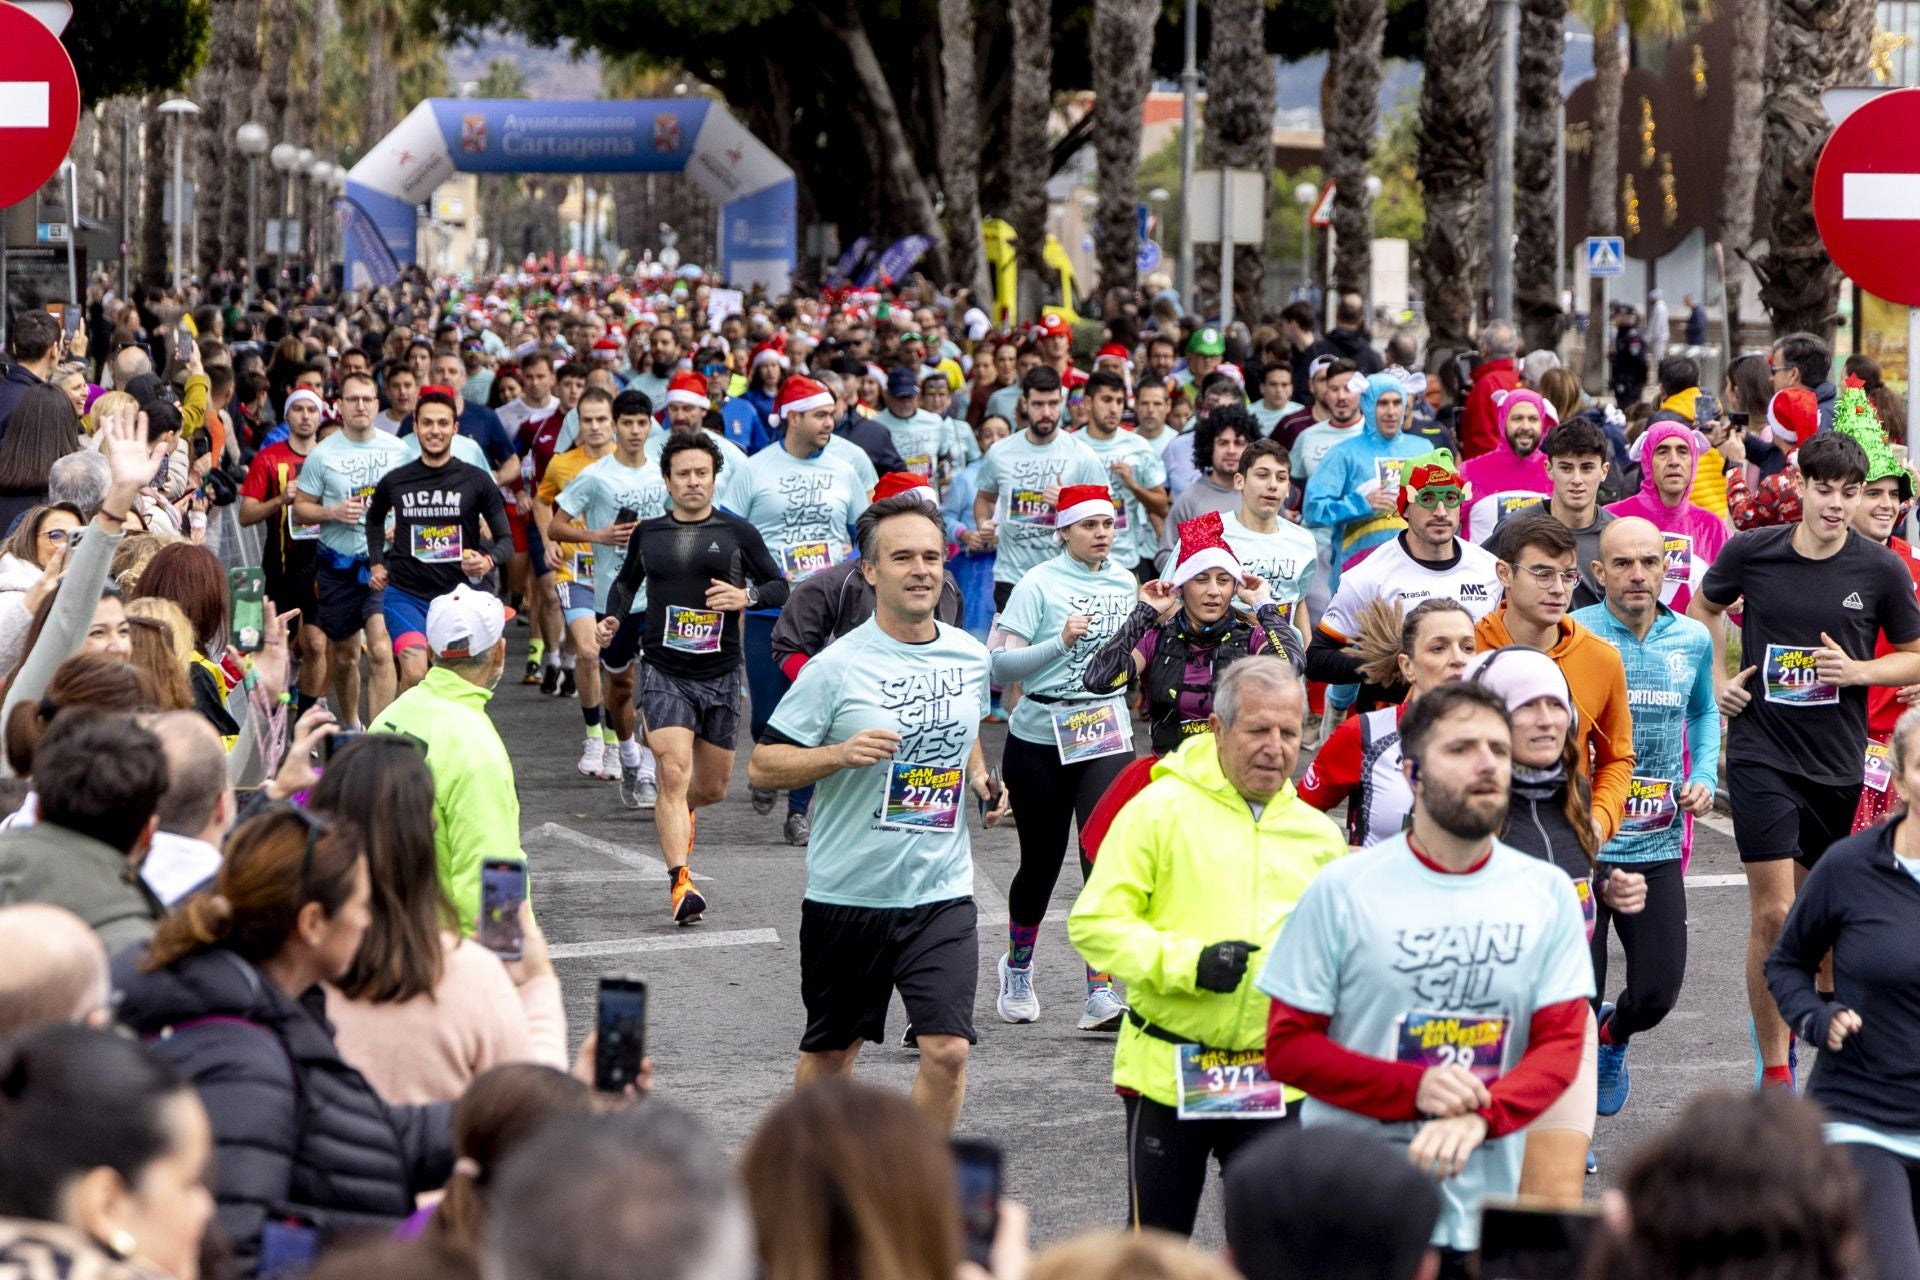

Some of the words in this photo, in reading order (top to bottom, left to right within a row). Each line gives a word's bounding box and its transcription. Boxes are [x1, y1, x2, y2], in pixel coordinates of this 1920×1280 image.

[504, 113, 636, 131] Ayuntamiento
[502, 132, 634, 157] Cartagena
[1013, 459, 1068, 480] SAN
[779, 472, 833, 494] SAN
[401, 489, 462, 508] UCAM
[786, 490, 827, 516] SIL
[1016, 499, 1051, 516] 1159
[402, 507, 460, 517] UNIVERSIDAD
[782, 507, 834, 528] VES
[425, 536, 450, 550] 363
[677, 621, 713, 640] 1807
[1782, 651, 1802, 660] SAN
[879, 668, 963, 709] SAN
[897, 699, 959, 739] SIL
[1070, 711, 1087, 722] SAN
[1076, 722, 1105, 743] 467
[908, 771, 961, 787] SILVESTRE
[909, 768, 934, 778] SAN
[902, 785, 954, 810] 2743
[1393, 921, 1524, 973] SAN
[1413, 967, 1500, 1011] SIL
[1437, 1044, 1475, 1072] 29
[1207, 1066, 1255, 1092] 371
